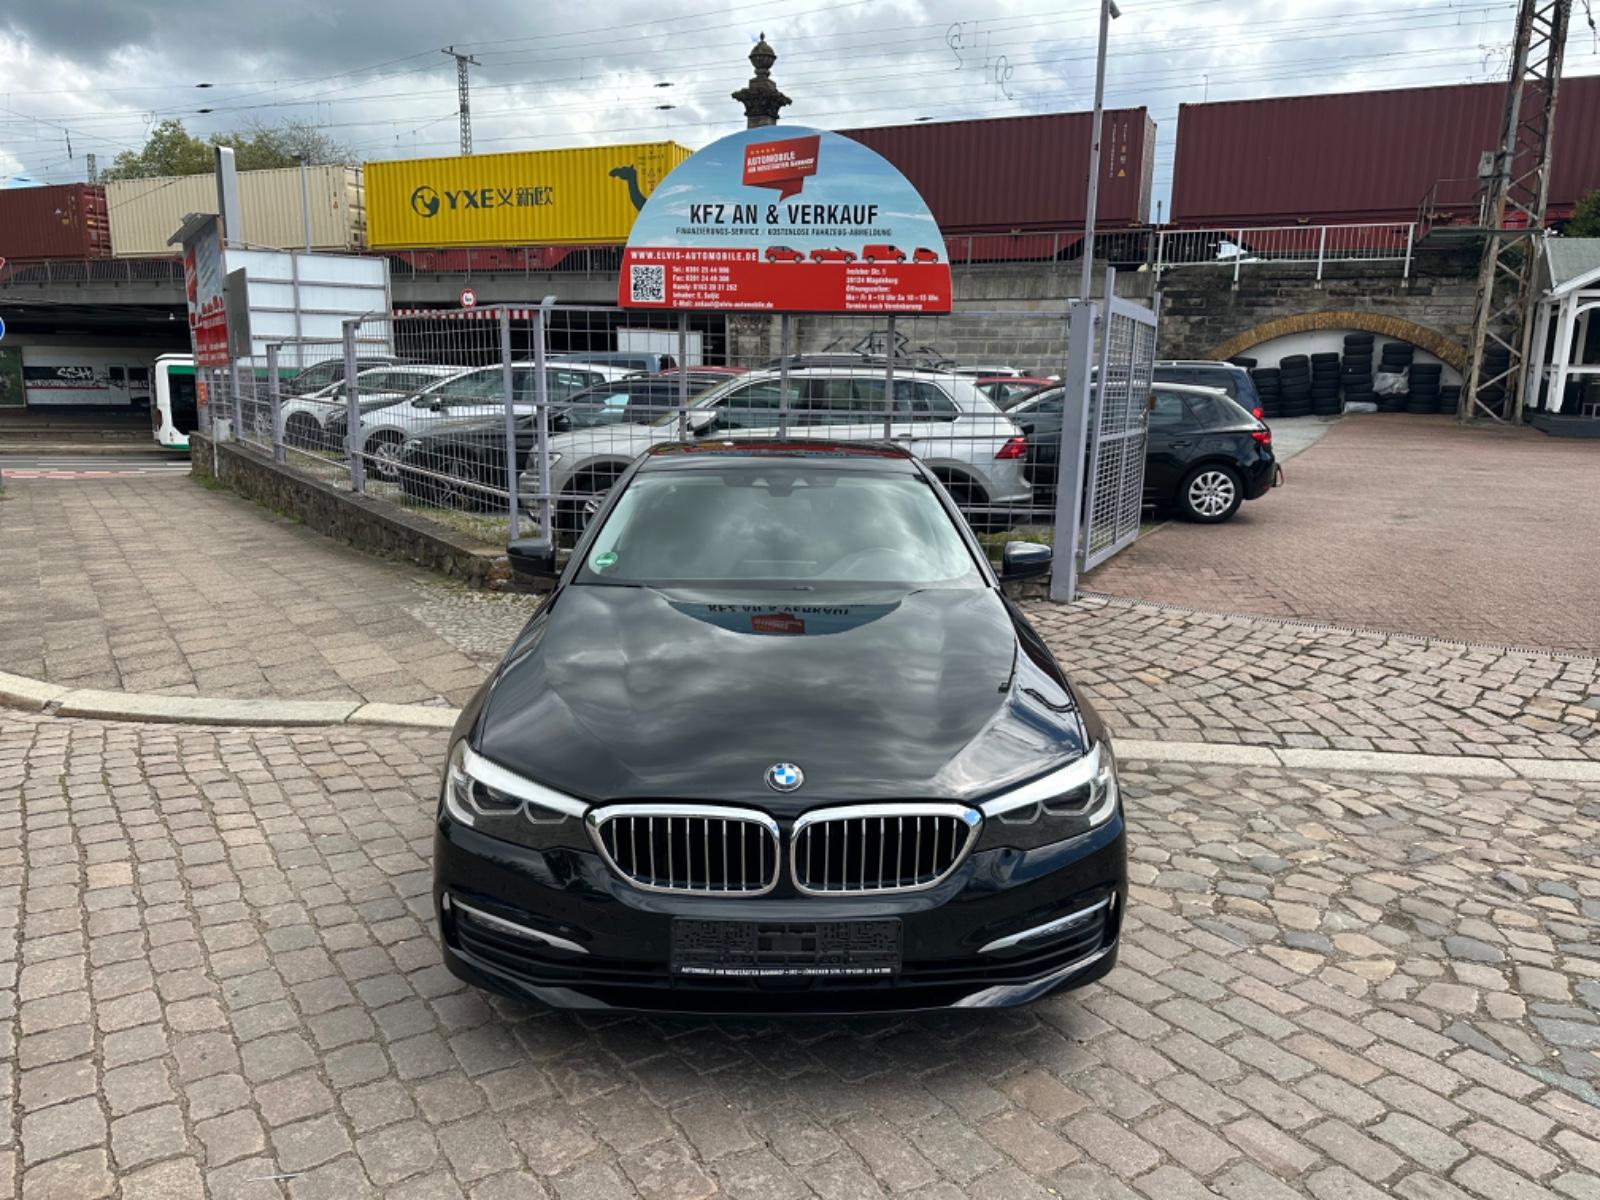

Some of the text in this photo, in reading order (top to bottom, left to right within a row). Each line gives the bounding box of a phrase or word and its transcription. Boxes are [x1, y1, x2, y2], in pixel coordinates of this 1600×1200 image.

[747, 151, 796, 166] AUTOMOBILE
[444, 188, 494, 209] YXE
[690, 204, 879, 224] KFZ AN & VERKAUF
[676, 228, 759, 236] FINANZIERUNGS-SERVICE
[768, 228, 809, 236] KOSTENLOSE
[630, 251, 757, 261] WWW.ELVIS-AUTOMOBILE.DE
